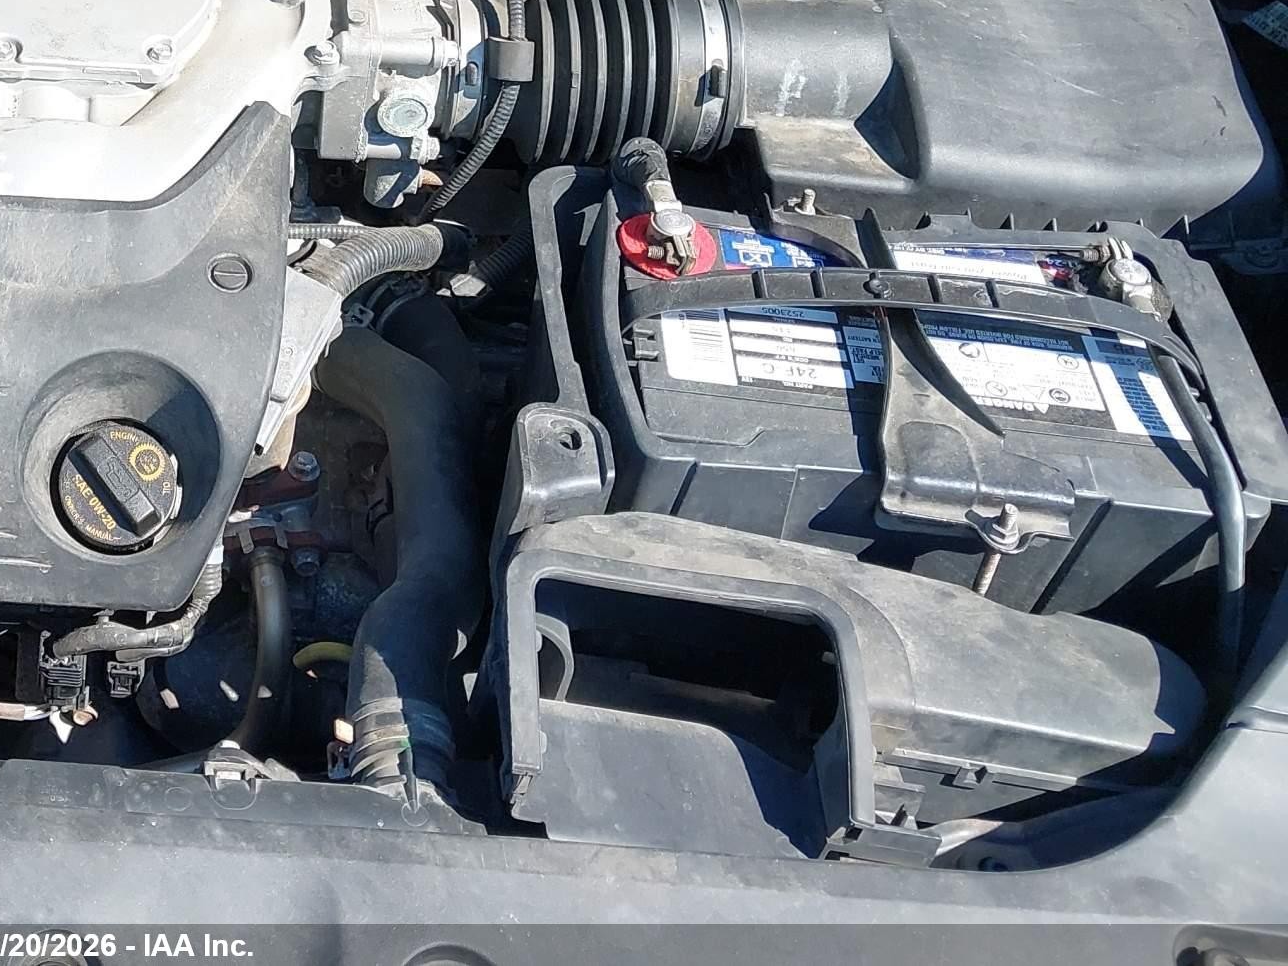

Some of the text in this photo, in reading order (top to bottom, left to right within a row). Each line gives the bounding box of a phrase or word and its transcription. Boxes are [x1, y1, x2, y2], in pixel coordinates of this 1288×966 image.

[971, 395, 1034, 412] DANGER
[162, 480, 173, 496] OIL
[71, 473, 117, 530] SAE 0W-20
[85, 524, 113, 541] MANUAL
